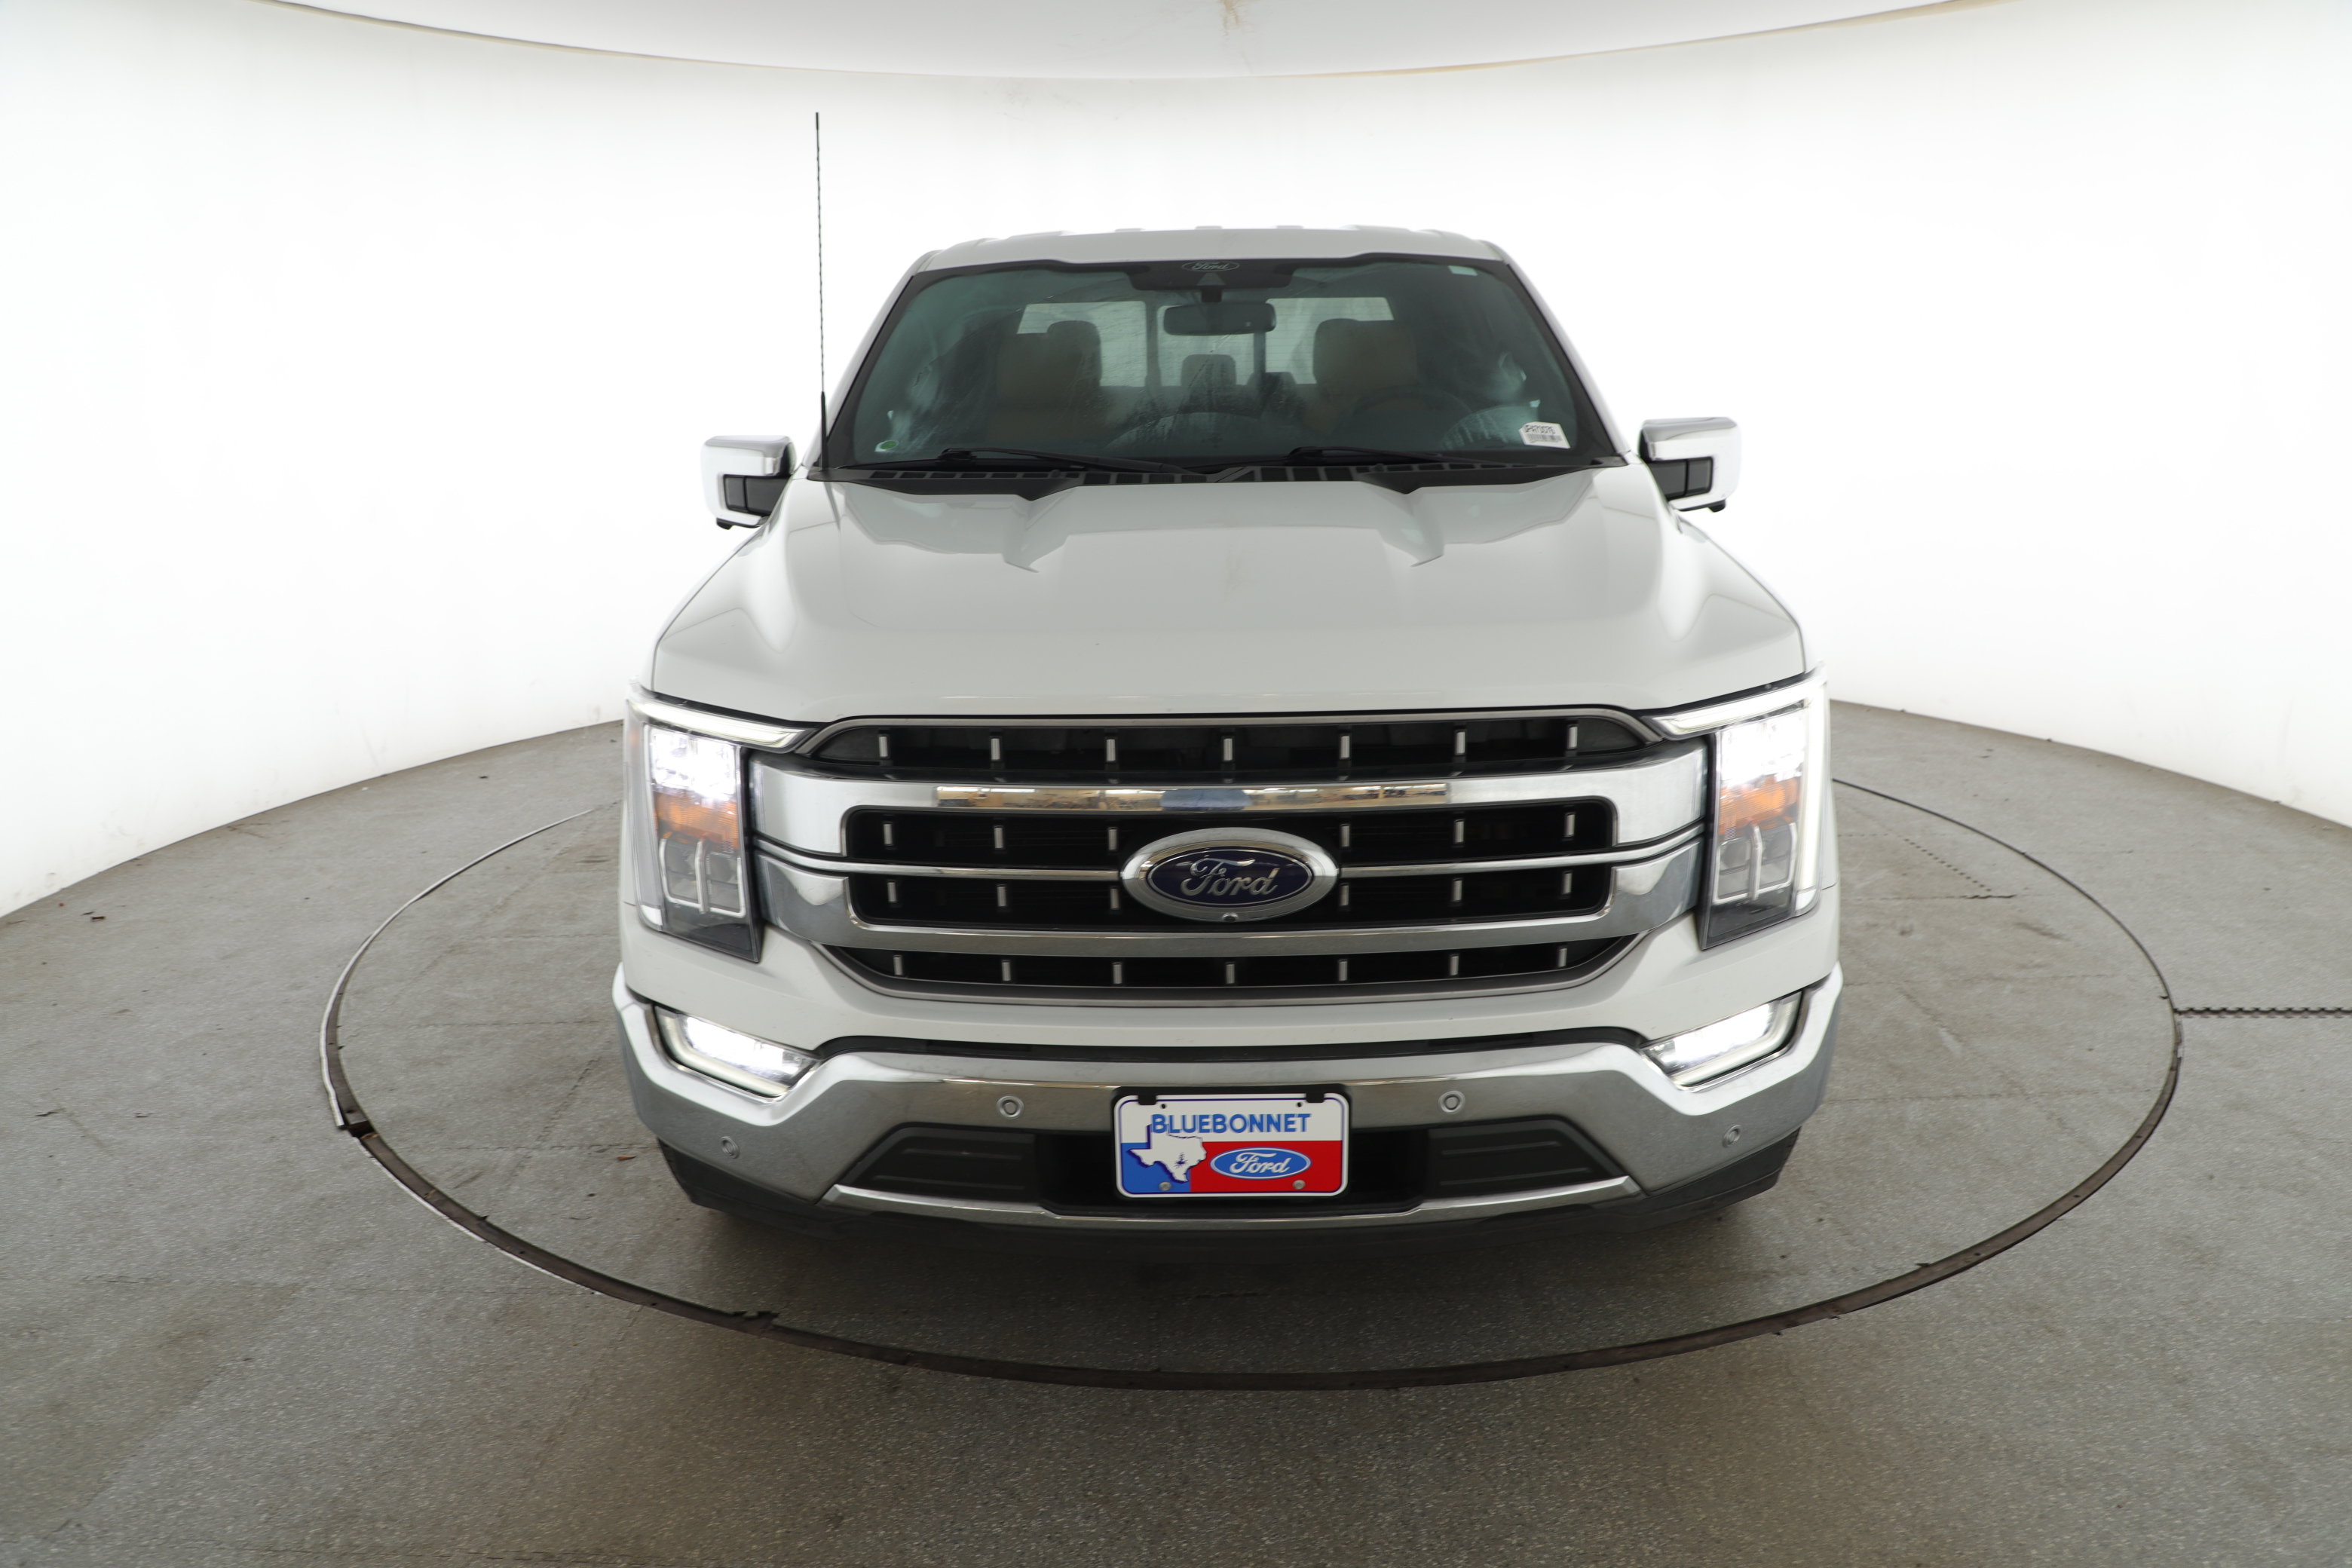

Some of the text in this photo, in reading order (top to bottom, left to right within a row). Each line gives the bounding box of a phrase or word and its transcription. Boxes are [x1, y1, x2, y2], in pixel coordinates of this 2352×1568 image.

[1191, 260, 1230, 271] Ford
[1181, 857, 1281, 896] Ford
[1150, 1113, 1312, 1134] BLUEBONNET
[1230, 1151, 1292, 1174] Ford
